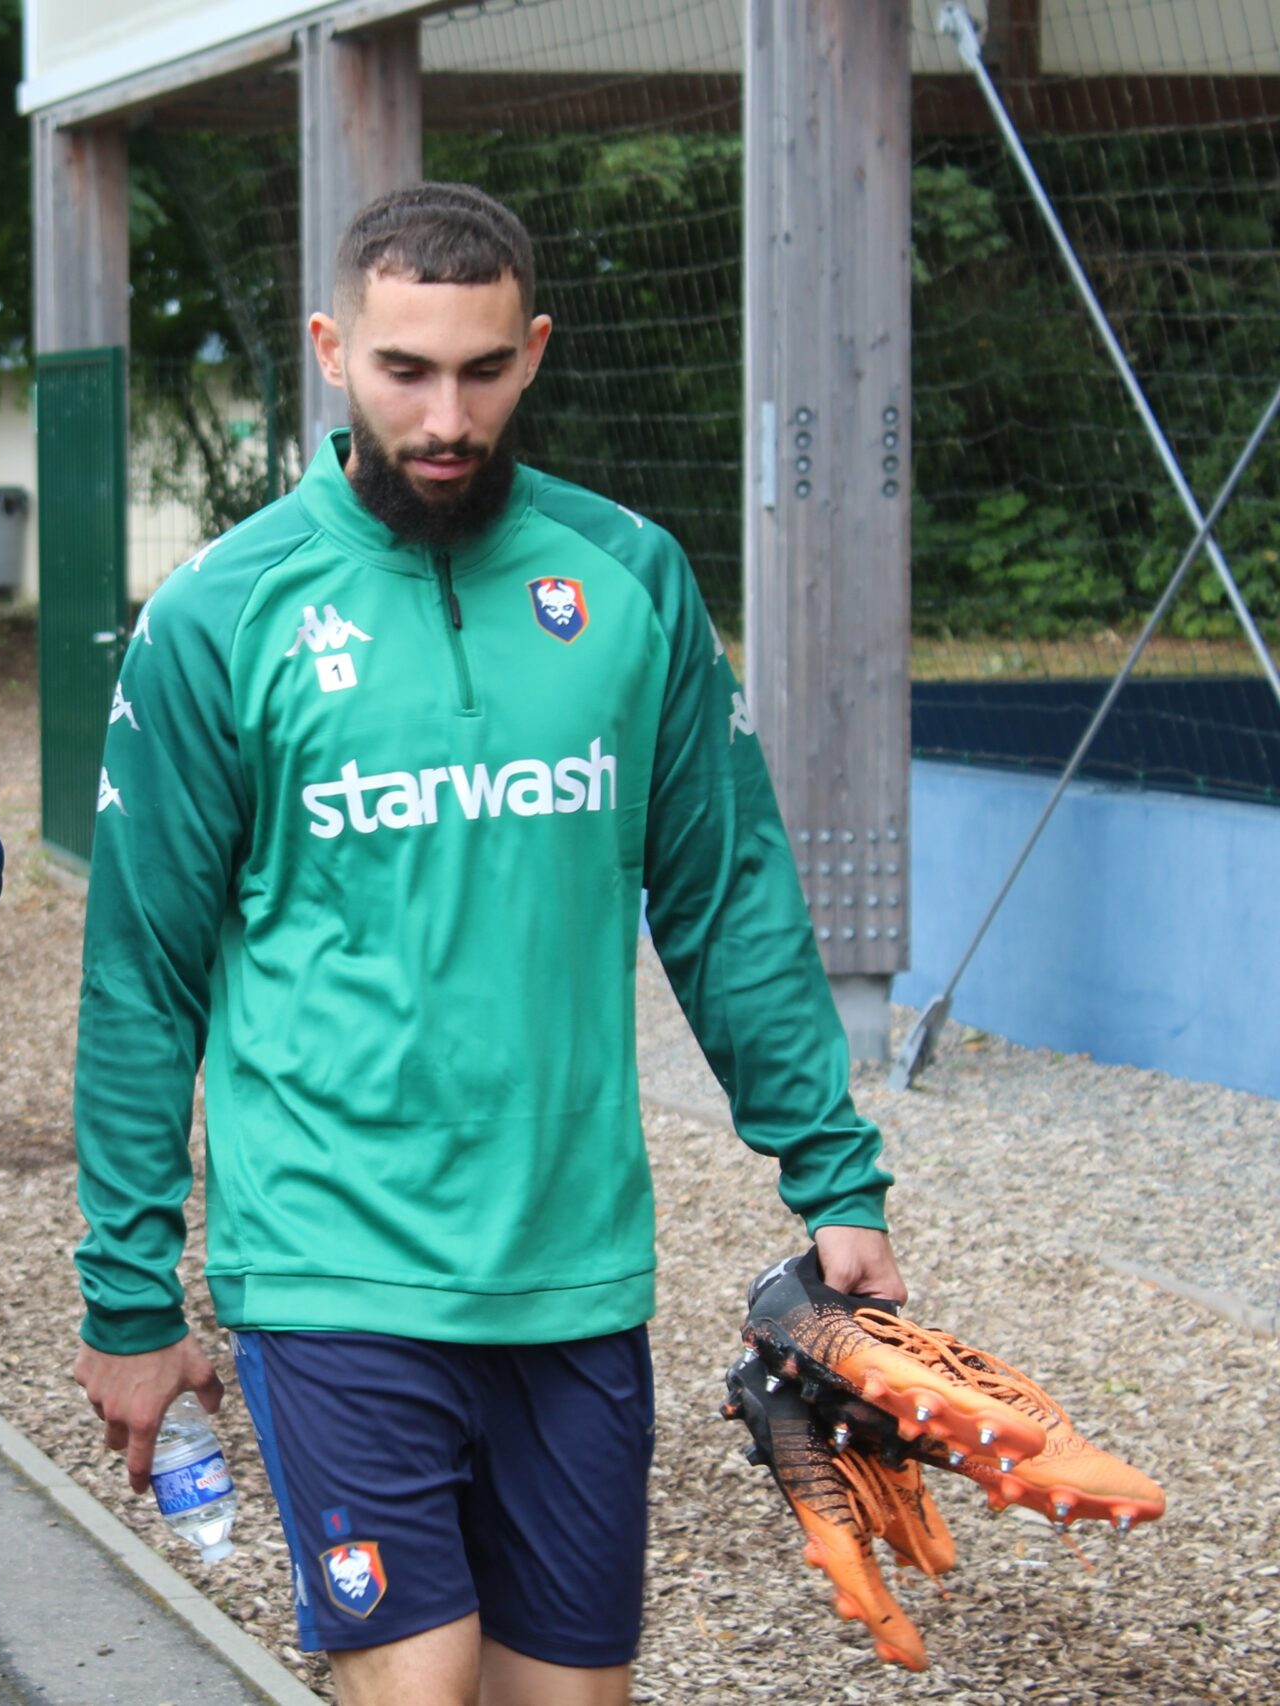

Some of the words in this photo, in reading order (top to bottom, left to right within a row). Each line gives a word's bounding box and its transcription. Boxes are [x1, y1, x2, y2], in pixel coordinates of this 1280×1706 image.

[330, 664, 344, 683] 1
[301, 736, 617, 839] starwash
[330, 1513, 342, 1532] 1
